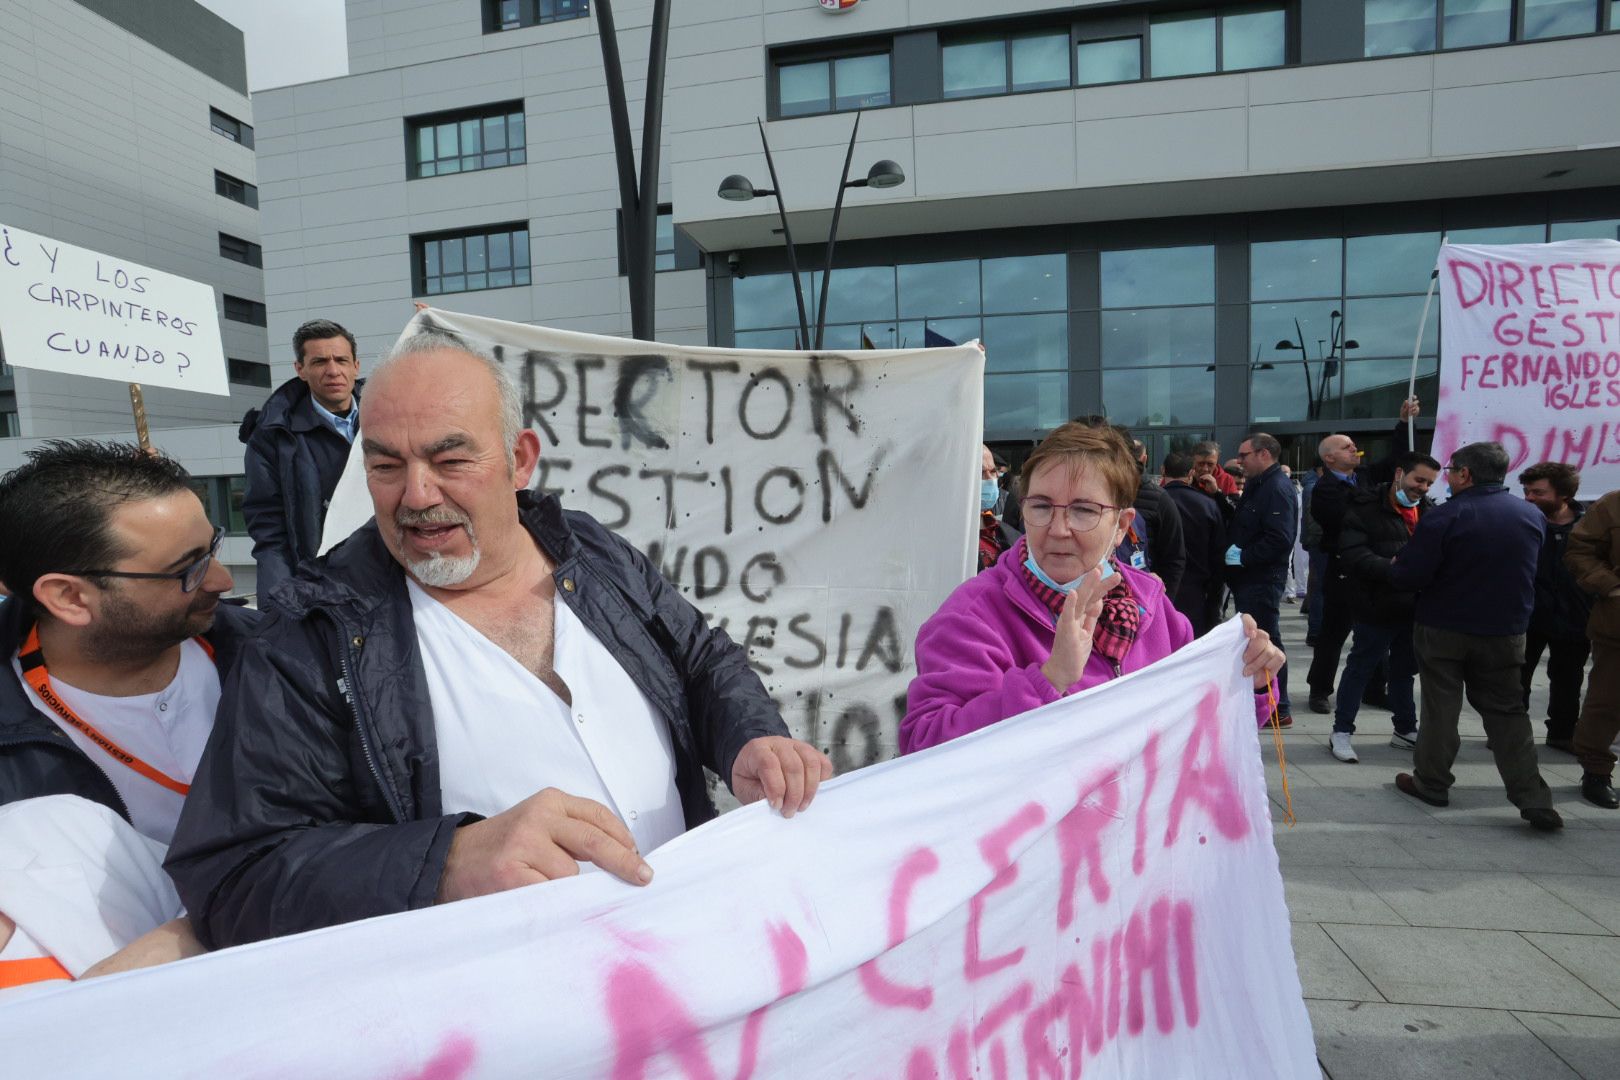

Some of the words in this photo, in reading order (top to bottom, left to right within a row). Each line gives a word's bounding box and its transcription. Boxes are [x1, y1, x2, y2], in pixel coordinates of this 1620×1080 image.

[96, 260, 151, 293] LOS
[28, 282, 198, 336] CARPINTEROS
[1494, 312, 1620, 348] GEST
[1460, 351, 1620, 391] FERNANDO
[492, 347, 865, 451] RECTOR
[536, 447, 889, 535] ESTION
[38, 683, 83, 729] SERVICIOS
